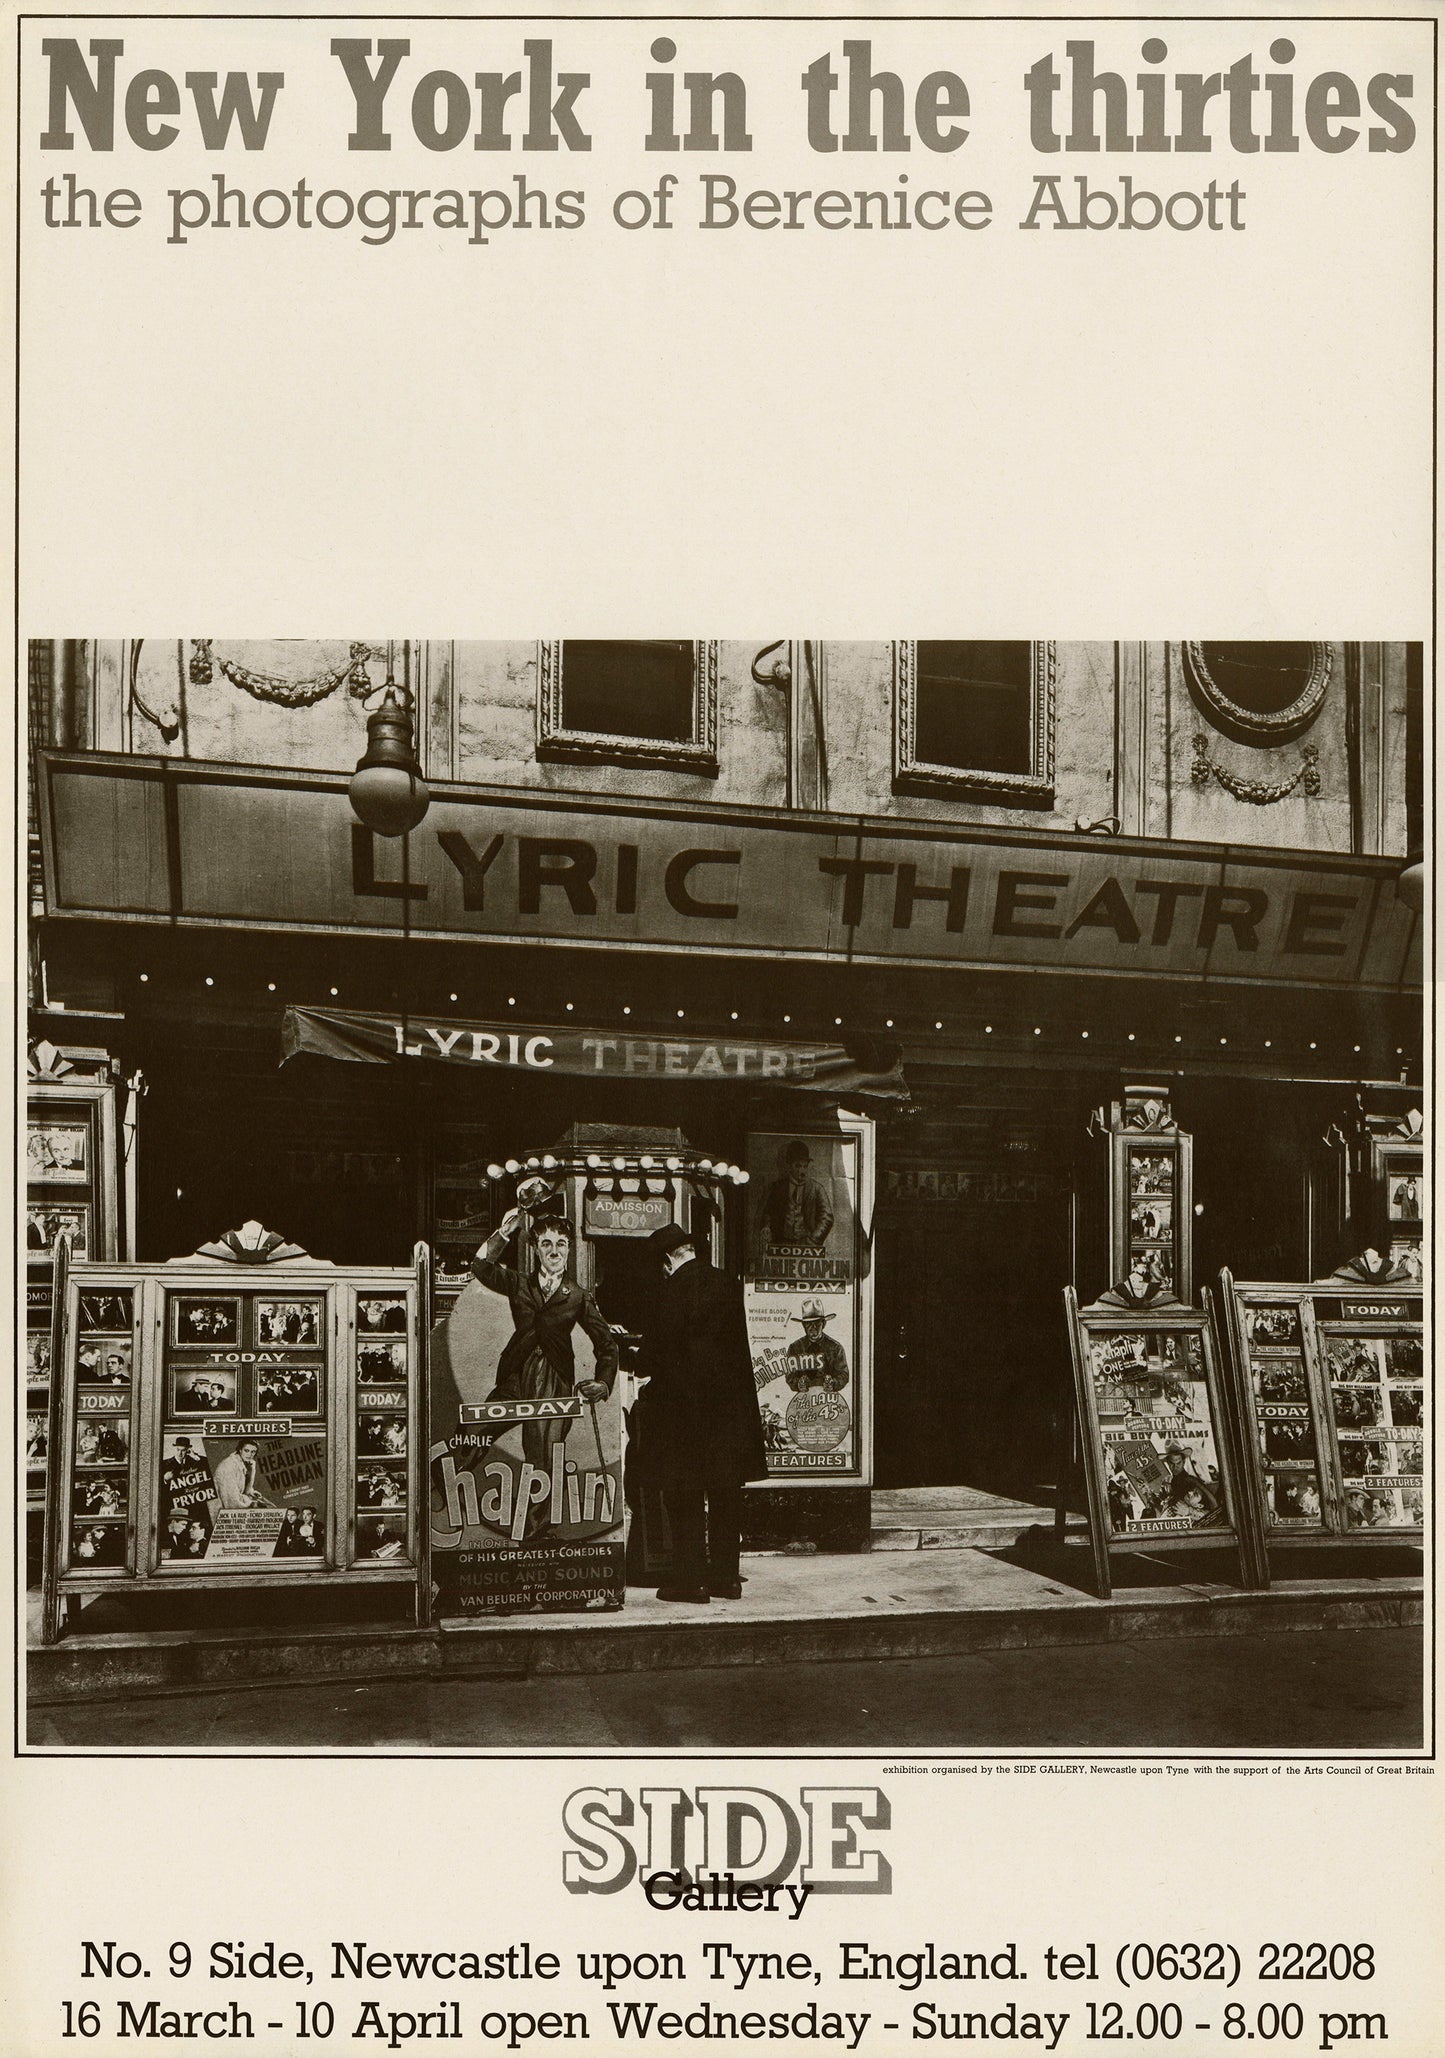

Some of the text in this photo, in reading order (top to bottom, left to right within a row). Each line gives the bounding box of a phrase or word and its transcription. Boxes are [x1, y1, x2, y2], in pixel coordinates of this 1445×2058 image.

[40, 37, 1416, 153] New York in the thirties
[41, 174, 1246, 245] the photographs of Berenice Abbott
[351, 822, 1360, 956] LYRIC THEATRE
[394, 1024, 816, 1078] LYRIC THEATRE
[594, 1200, 662, 1214] ADMISSION
[769, 1246, 824, 1257] TODAY
[798, 1259, 850, 1278] CHAPLIN
[760, 1281, 842, 1293] TO-DAY
[1346, 1305, 1401, 1315] TODAY
[210, 1353, 286, 1363] TODAY
[1103, 1361, 1124, 1374] ONE
[80, 1395, 125, 1408] TODAY
[361, 1393, 401, 1406] TODAY
[811, 1392, 839, 1407] LAW
[467, 1400, 575, 1419] TO-DAY
[1256, 1406, 1309, 1417] TODAY
[209, 1423, 287, 1433] 2 FEATURES
[1149, 1417, 1183, 1430] TO-DAY
[450, 1434, 493, 1449] CHARLIE
[1105, 1430, 1209, 1441] BIG BOY WILLIAMS
[1386, 1428, 1418, 1440] TO-DAY
[265, 1439, 283, 1451] THE
[257, 1441, 324, 1475] HEADLINE
[773, 1455, 842, 1466] FEATURES
[169, 1470, 212, 1491] ANGEL
[265, 1460, 324, 1492] WOMAN
[1376, 1478, 1420, 1487] FEATURES
[172, 1488, 217, 1509] PRYOR
[431, 1440, 617, 1548] Chaplin
[1132, 1520, 1190, 1531] 2 FEATURES
[469, 1538, 509, 1549] IN ONE
[459, 1546, 612, 1563] OF HIS GREATEST COMEDIES
[460, 1566, 614, 1586] MUSIC AND SOUND
[460, 1588, 615, 1607] VAN BEUREN CORPORATION
[882, 1765, 1435, 1776] exhibition organised by the SIDE GALLERY, Newcastle upon Tyne with the support of the Arts Council of Great Britain
[562, 1786, 892, 1894] SIDE
[645, 1871, 814, 1920] Gallery
[81, 1941, 1375, 1990] No. 9 Side, Newcastle upon Tyne, England. tel (0632) 22208
[62, 2001, 100, 2037] 16
[117, 2001, 254, 2038] March
[296, 2002, 334, 2038] 10
[352, 2001, 462, 2048] April
[481, 2013, 589, 2048] open
[607, 2003, 871, 2049] Wednesday
[913, 2003, 1070, 2049] Sunday
[1086, 2002, 1182, 2039] 12.00
[1224, 2003, 1303, 2039] 8.00
[1319, 2014, 1388, 2050] pm
